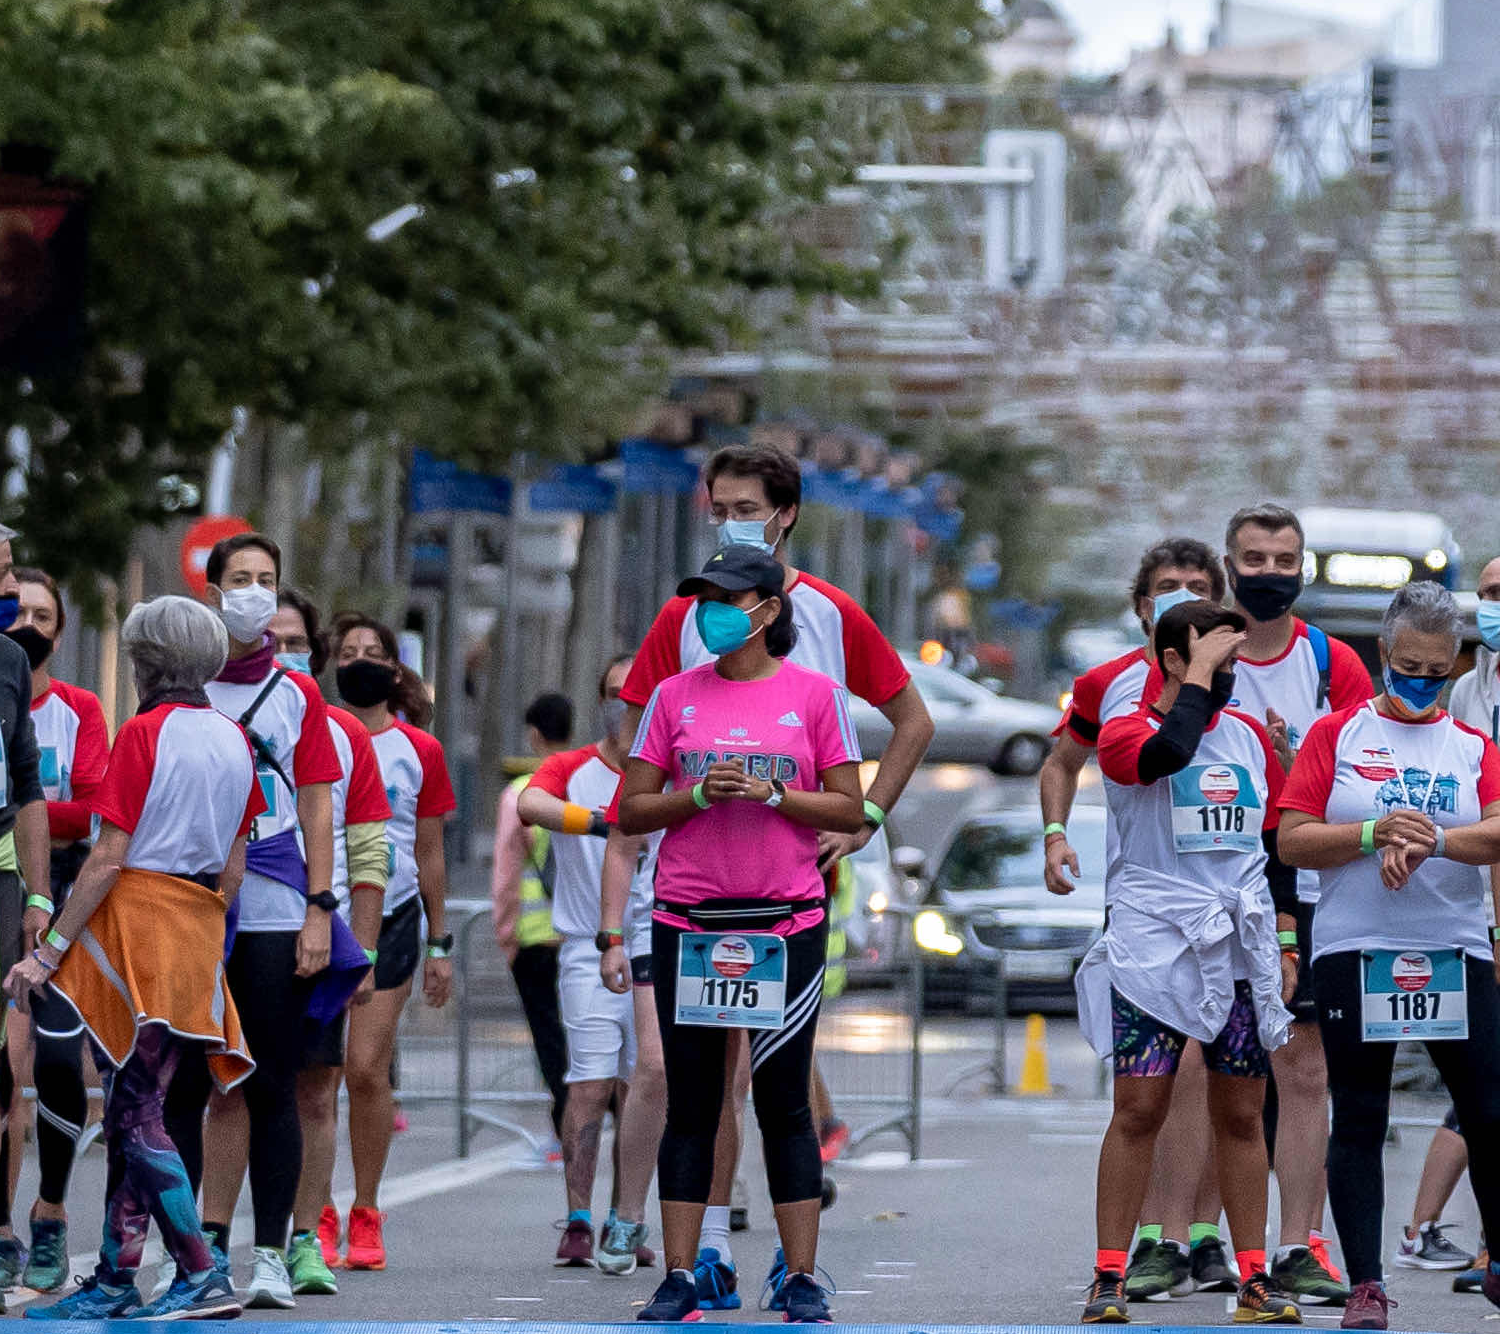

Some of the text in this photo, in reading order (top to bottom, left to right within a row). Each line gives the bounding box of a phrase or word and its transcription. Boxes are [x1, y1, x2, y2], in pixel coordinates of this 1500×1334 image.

[1197, 805, 1246, 833] 1178
[704, 978, 759, 1009] 1175
[1387, 992, 1441, 1021] 1187
